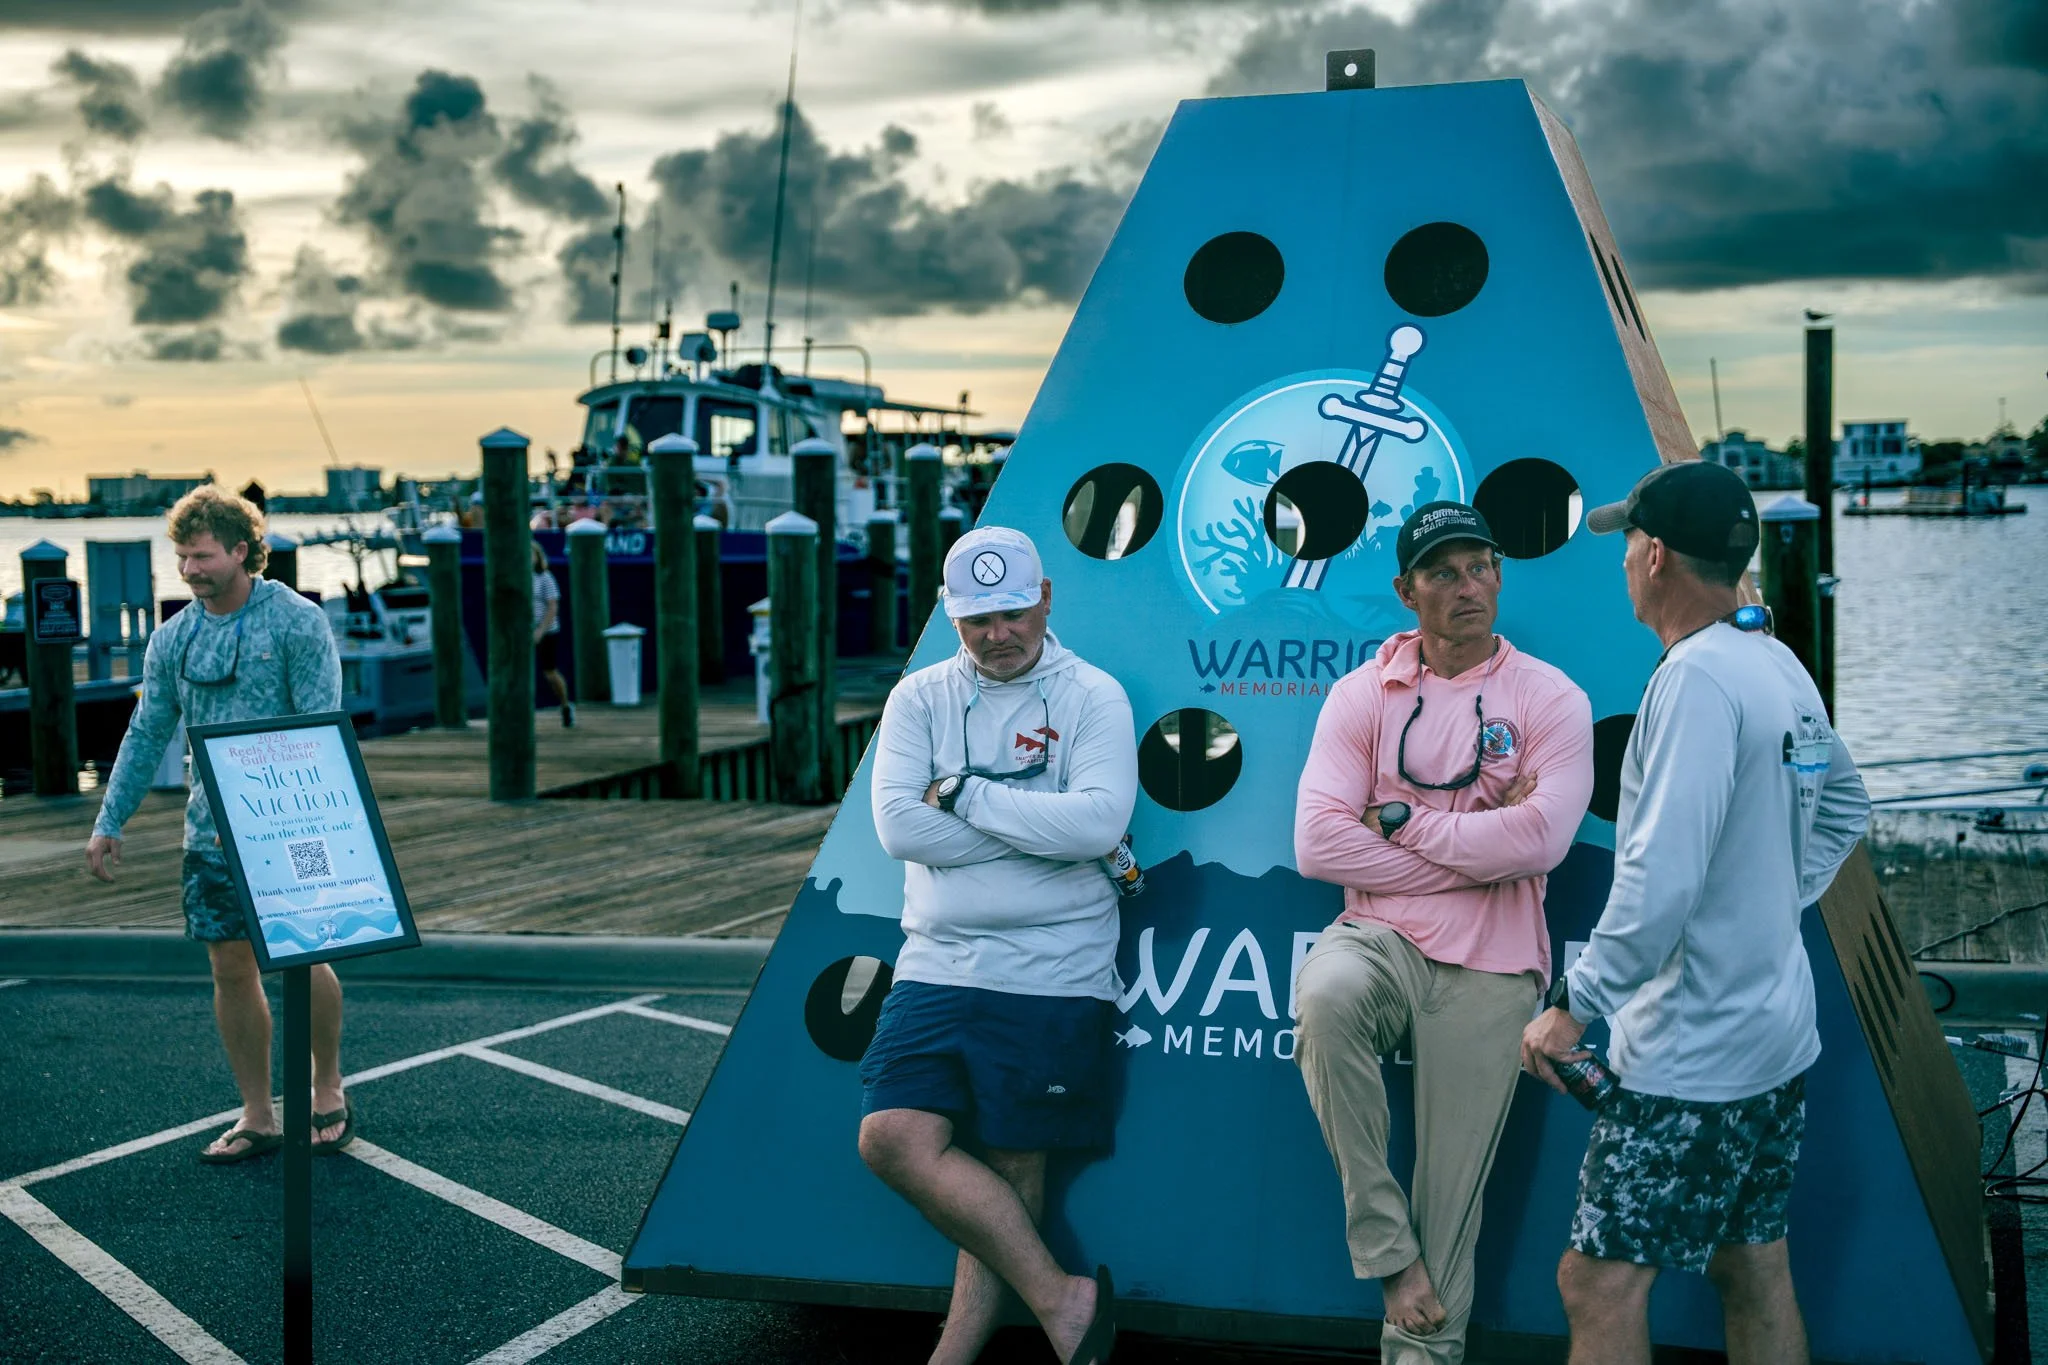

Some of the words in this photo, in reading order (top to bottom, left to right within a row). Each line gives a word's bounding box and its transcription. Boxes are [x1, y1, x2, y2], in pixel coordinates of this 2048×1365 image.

[1420, 508, 1461, 525] FLORIDA
[1413, 518, 1477, 541] SPEARFISHING
[603, 532, 646, 555] AND
[228, 745, 263, 758] Reels
[266, 743, 277, 754] &
[280, 740, 322, 755] Spears
[256, 732, 288, 745] 2026
[240, 754, 267, 767] Gulf
[272, 749, 316, 765] Classic
[244, 764, 324, 790] Silent
[239, 788, 351, 818] Auction
[281, 814, 326, 827] participate
[244, 832, 275, 843] Scan
[278, 827, 297, 840] the
[301, 824, 320, 835] QR
[322, 821, 353, 833] Code
[256, 887, 284, 898] Thank
[285, 886, 301, 897] you
[303, 883, 317, 892] for
[318, 880, 337, 890] your
[339, 874, 377, 888] support!
[1163, 1024, 1297, 1061] MEMO
